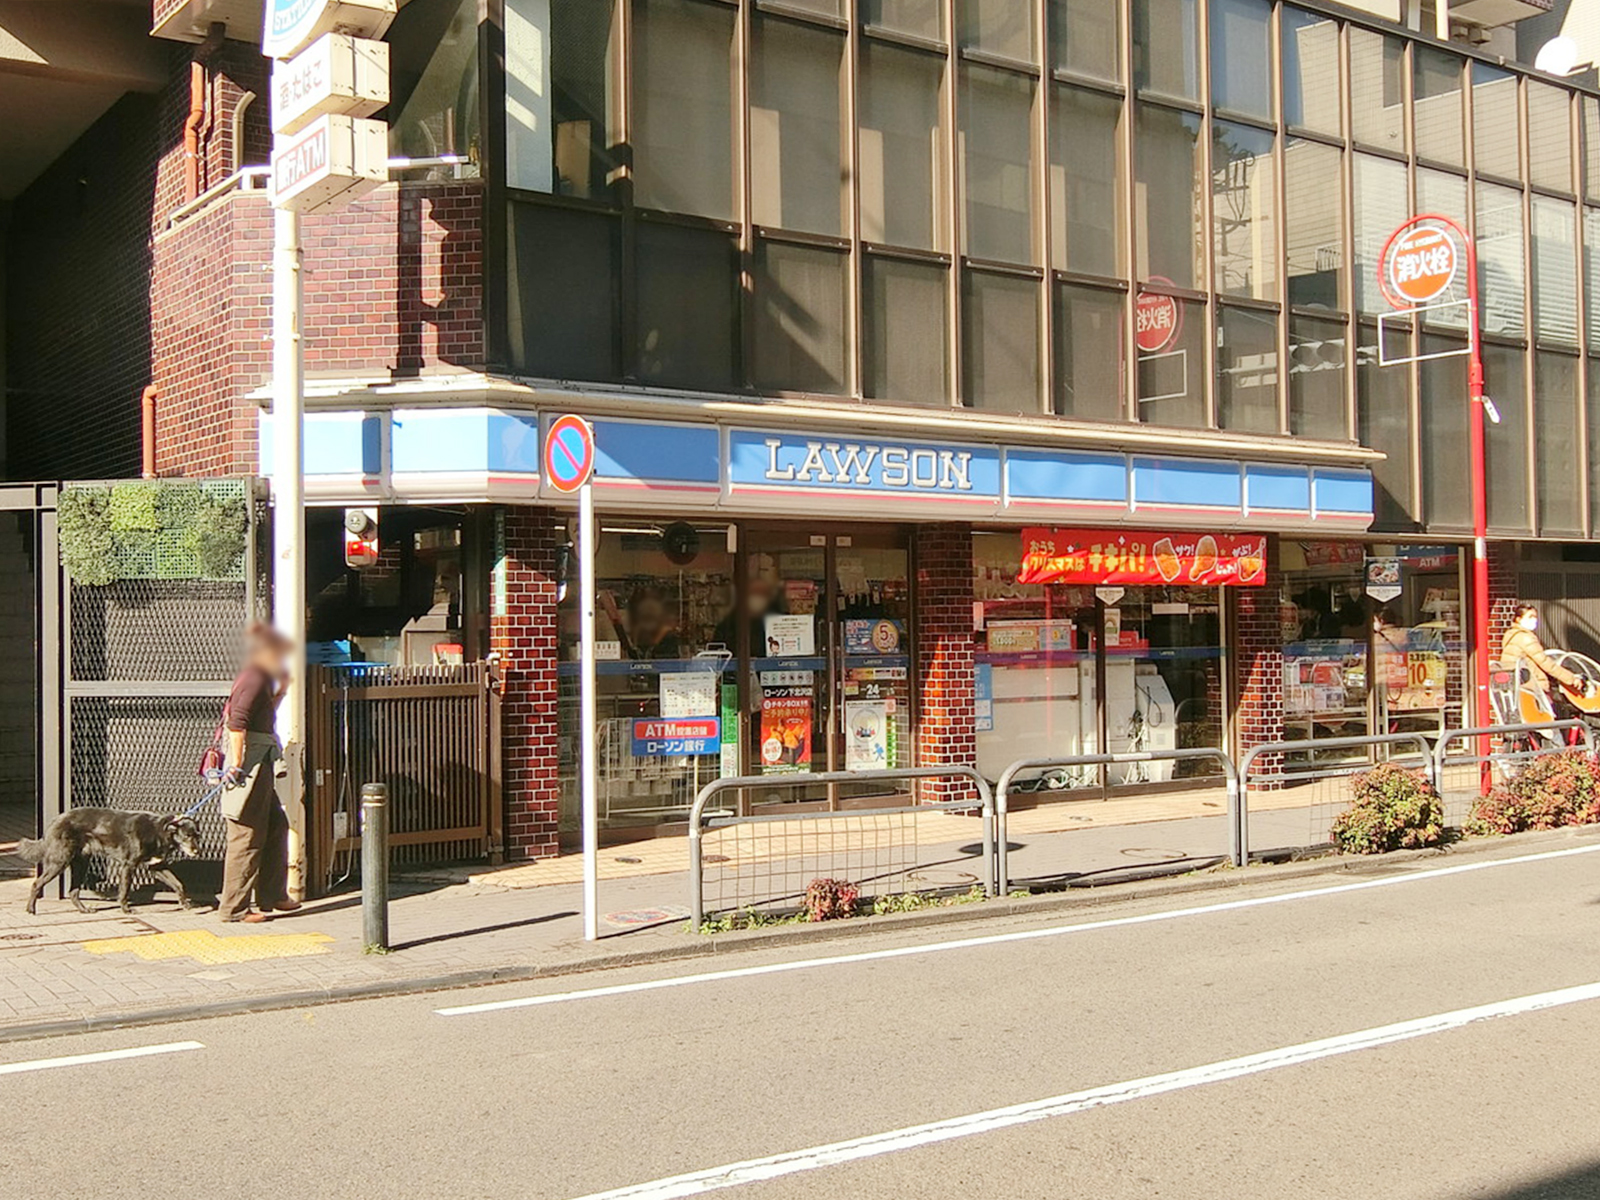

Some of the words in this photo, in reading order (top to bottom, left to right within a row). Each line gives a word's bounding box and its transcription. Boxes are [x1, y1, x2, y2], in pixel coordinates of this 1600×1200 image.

[1396, 245, 1451, 283] 消火栓
[765, 438, 973, 490] LAWSON
[1029, 540, 1055, 556] おうち
[1029, 556, 1086, 572] クリスマスは
[1419, 557, 1441, 568] ATM
[866, 684, 880, 695] 24
[647, 740, 705, 753] ローソン銀行
